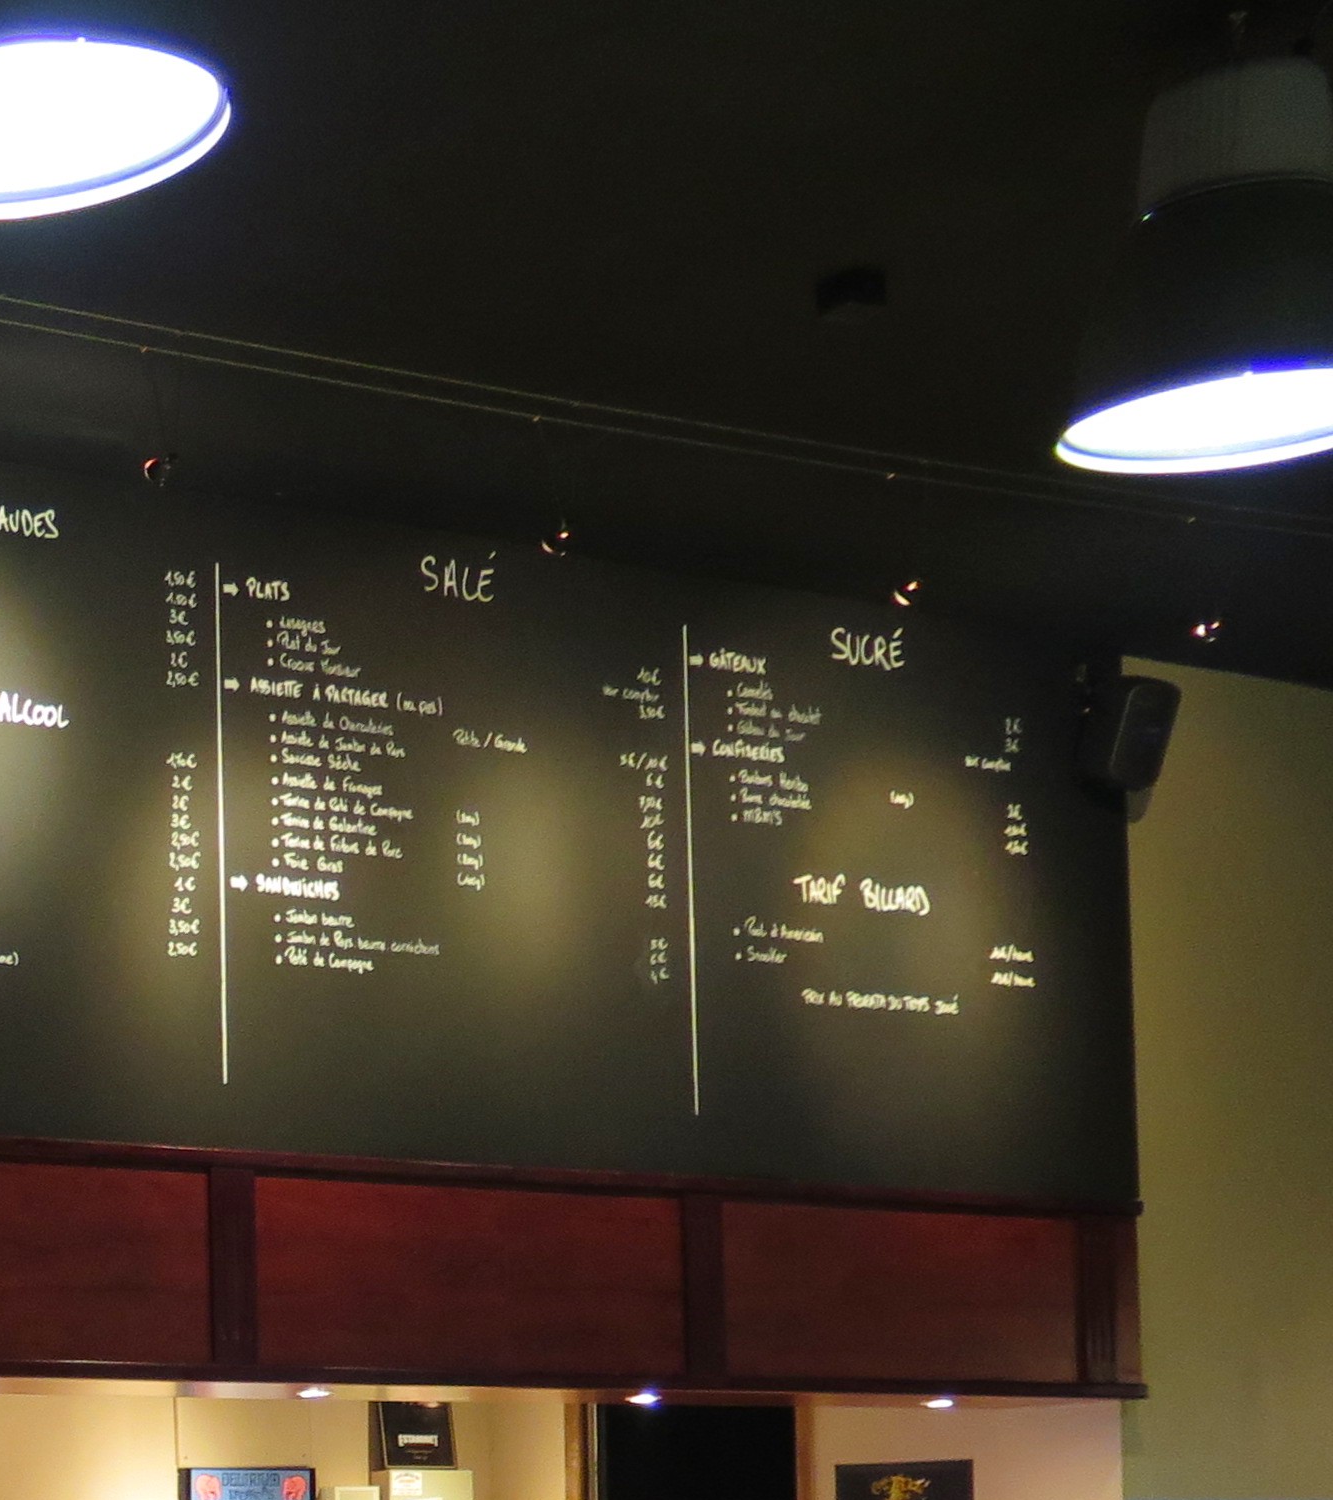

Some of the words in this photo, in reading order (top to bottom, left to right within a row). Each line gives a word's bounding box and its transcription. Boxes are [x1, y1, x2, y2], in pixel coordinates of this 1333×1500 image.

[246, 576, 290, 602] PLATS
[420, 551, 498, 603] SALÉ
[709, 648, 767, 676] GÂTEAUX
[831, 627, 906, 672] SUCRÉ
[250, 676, 304, 699] ASSIETTE
[324, 684, 389, 709] PARTAGER
[793, 872, 847, 905] TARIF
[859, 876, 931, 917] BILLARD
